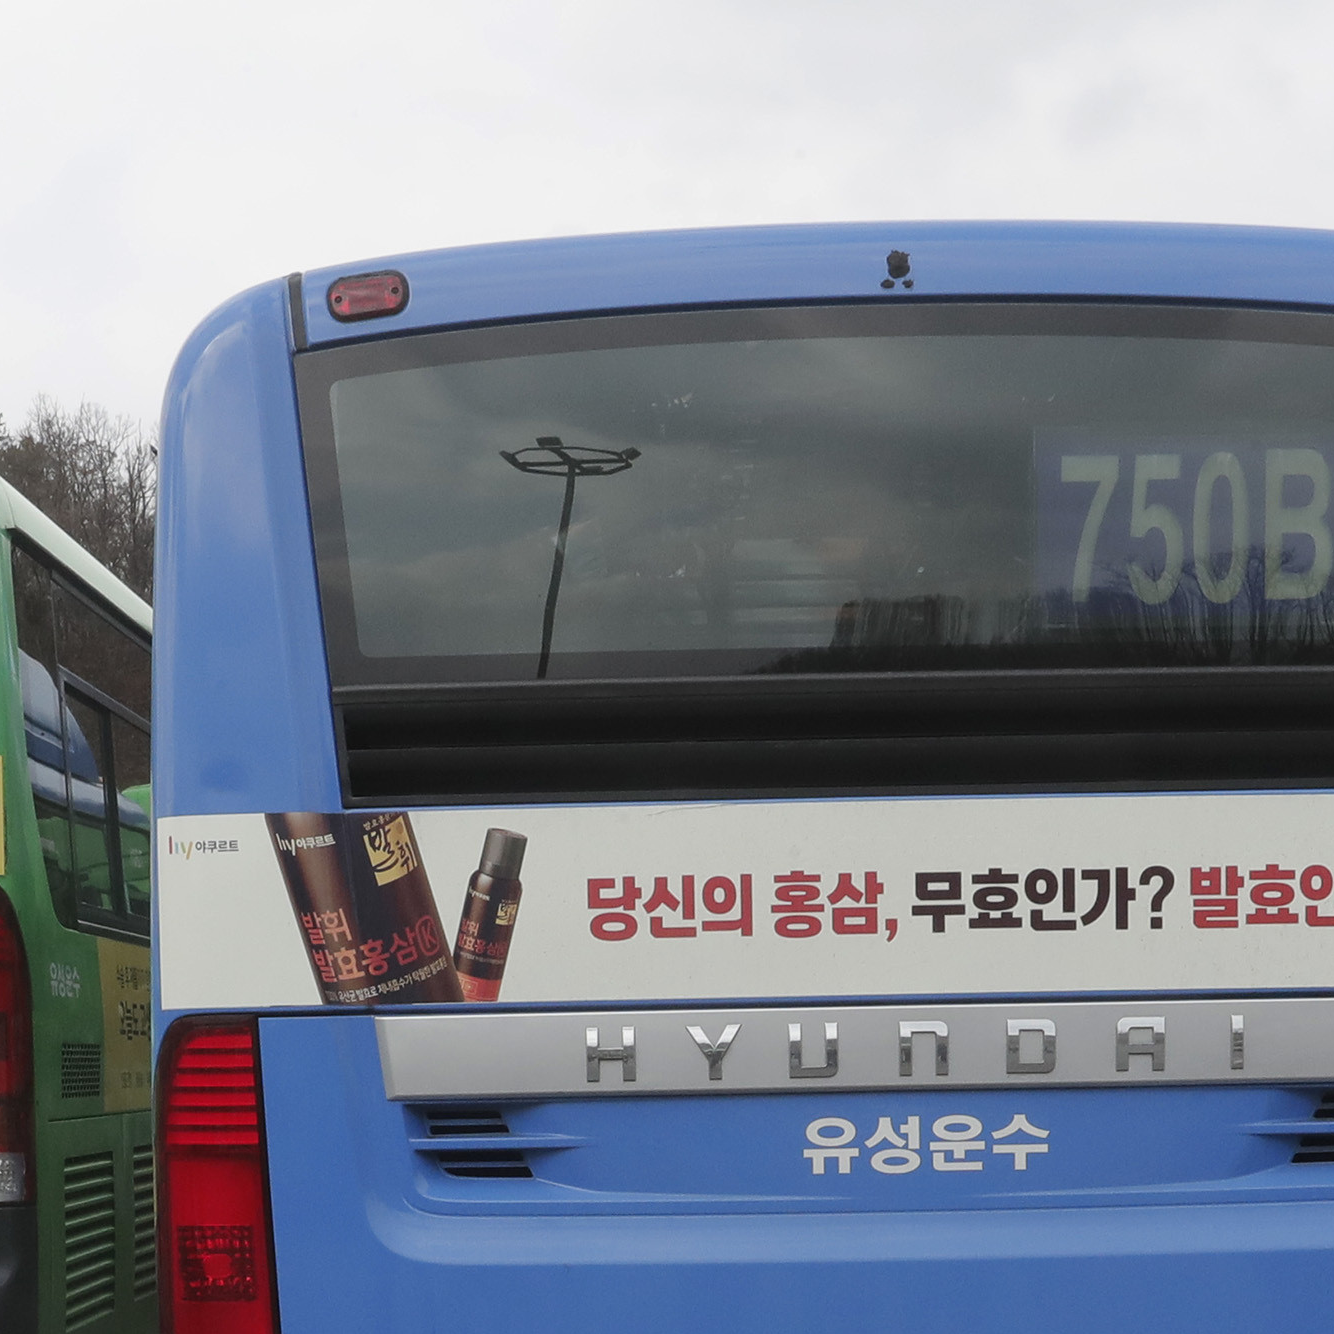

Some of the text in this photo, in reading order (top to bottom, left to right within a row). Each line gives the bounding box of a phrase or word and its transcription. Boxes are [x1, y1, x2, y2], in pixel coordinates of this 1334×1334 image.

[1061, 447, 1334, 605] 750B
[301, 908, 353, 945] 발휘
[586, 873, 754, 942] 당신의
[770, 869, 898, 943] 홍삼,
[911, 865, 1175, 934] 무효인가?
[585, 1014, 1245, 1083] HYUNDAI
[803, 1114, 1051, 1175] 유성운수
